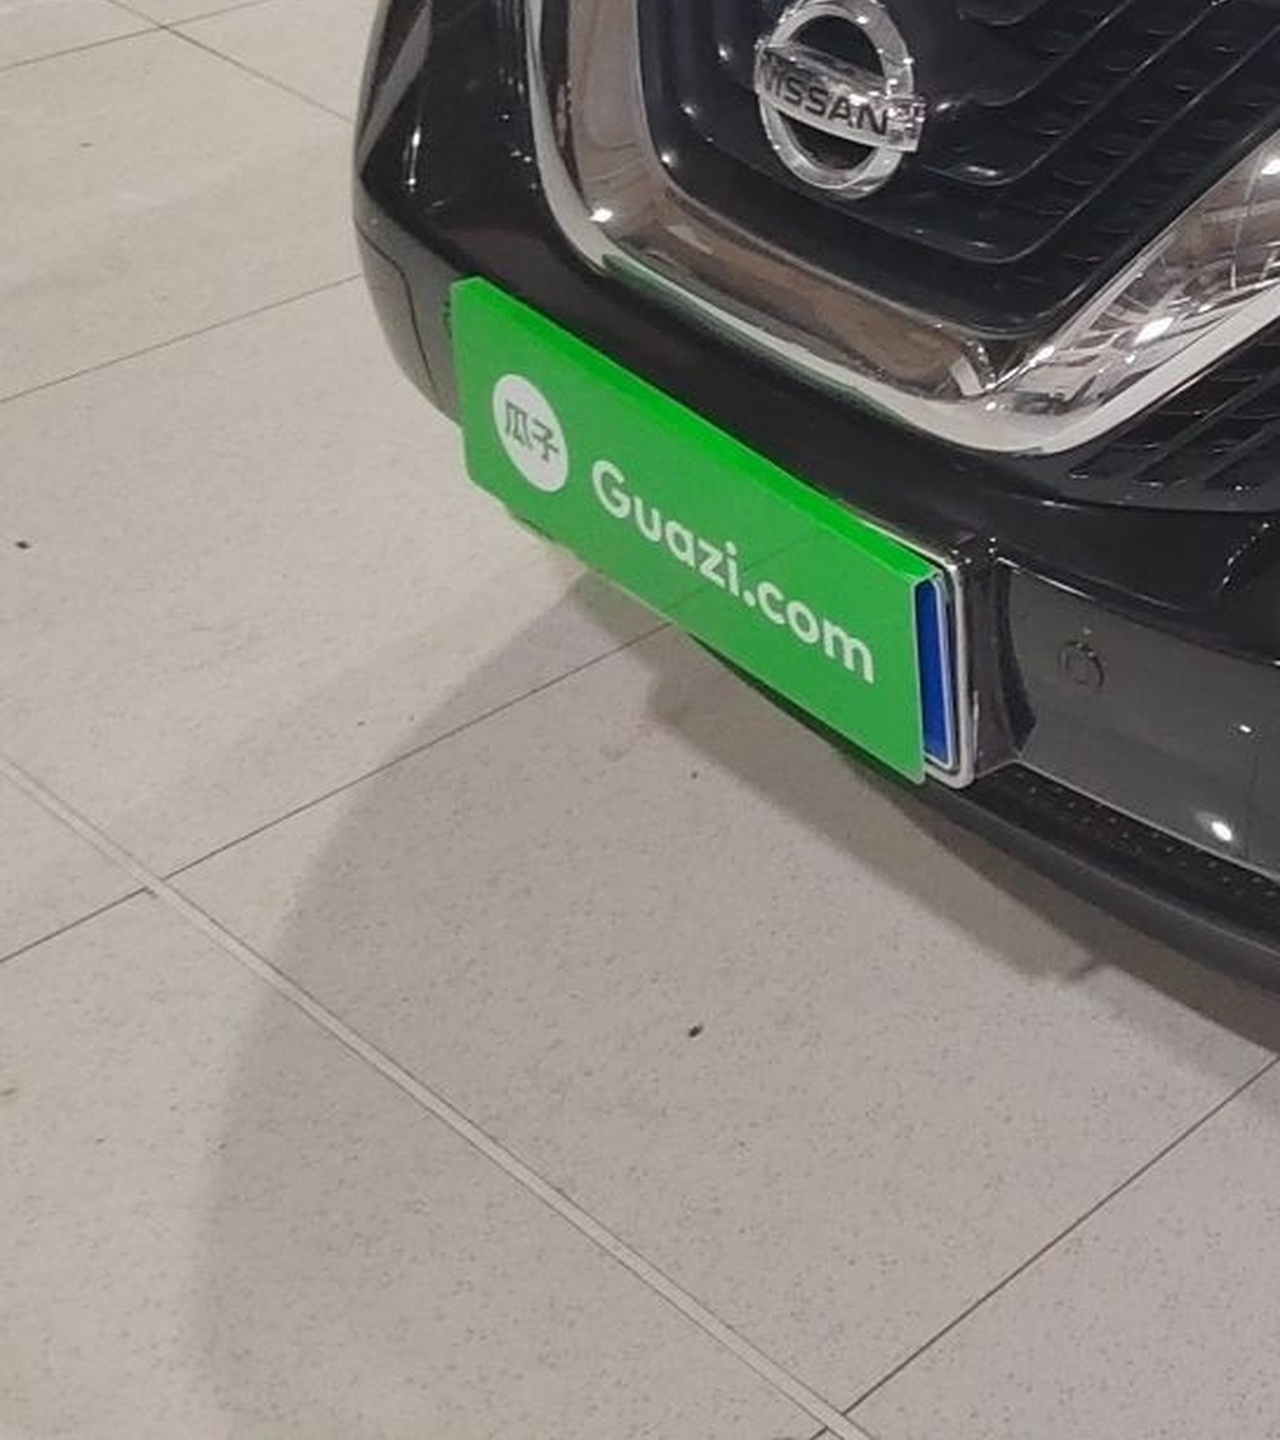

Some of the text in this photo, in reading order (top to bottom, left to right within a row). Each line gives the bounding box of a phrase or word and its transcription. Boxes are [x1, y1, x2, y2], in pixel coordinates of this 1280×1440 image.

[760, 54, 888, 136] NISSAN
[505, 401, 560, 463] 瓜子
[592, 459, 875, 685] Guazi.com
